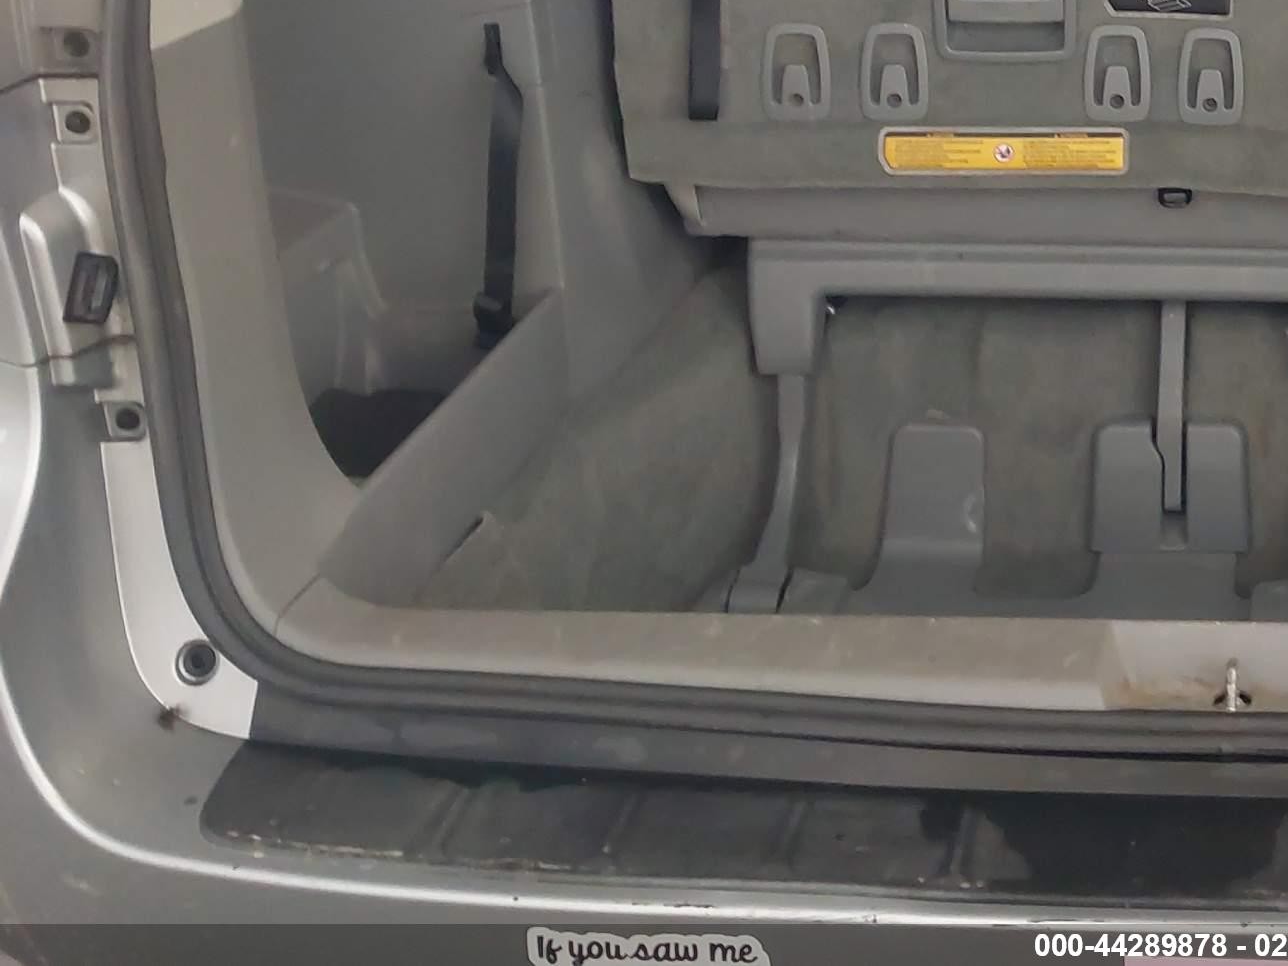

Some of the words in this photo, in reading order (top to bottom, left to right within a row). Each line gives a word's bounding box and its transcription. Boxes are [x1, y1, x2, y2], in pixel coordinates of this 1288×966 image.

[536, 935, 563, 964] If
[568, 940, 628, 966] you
[630, 941, 698, 963] saw
[709, 942, 758, 963] me
